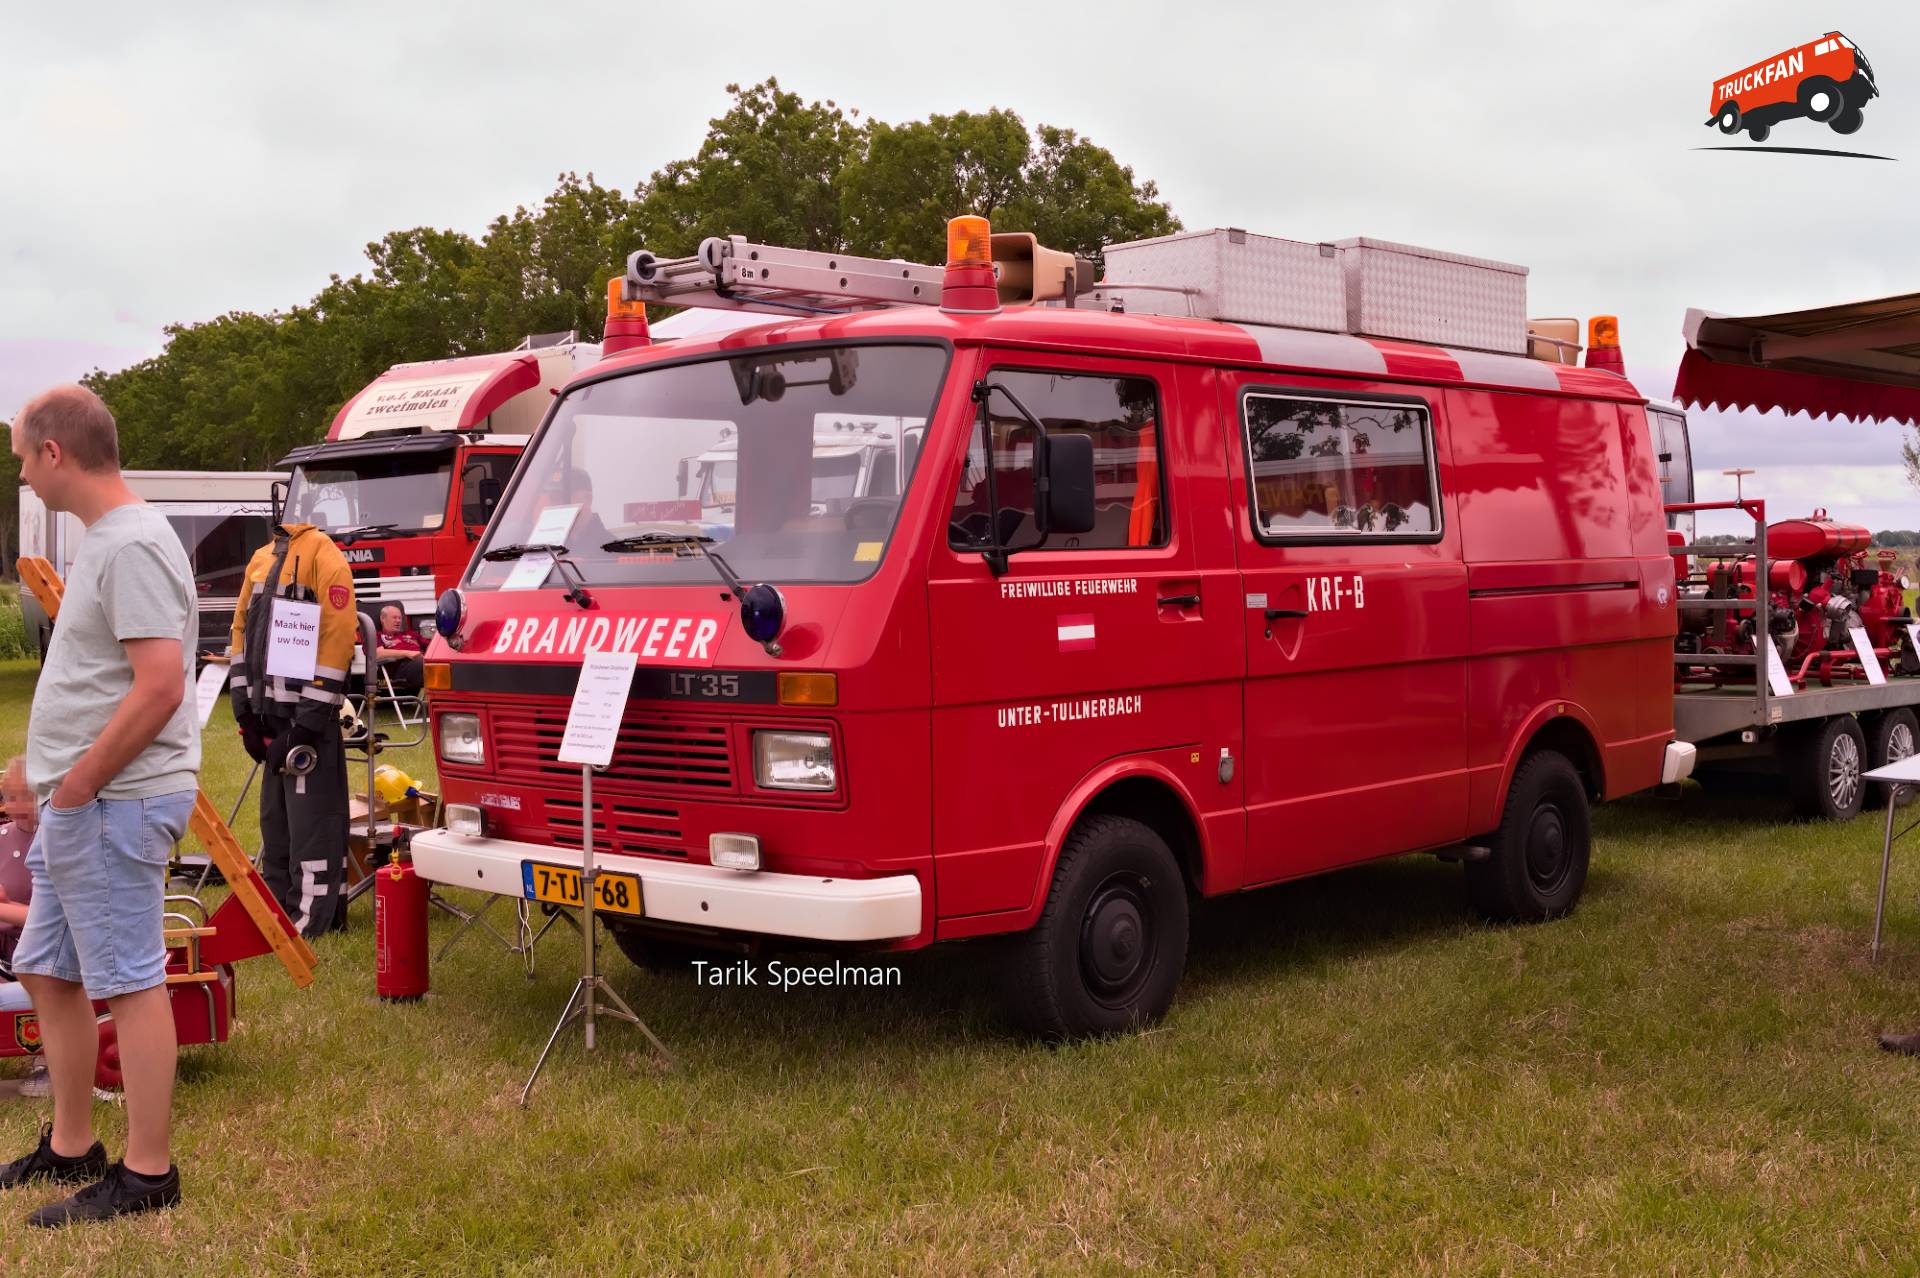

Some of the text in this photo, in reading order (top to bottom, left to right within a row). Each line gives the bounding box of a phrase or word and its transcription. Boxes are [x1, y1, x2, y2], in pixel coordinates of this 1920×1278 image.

[411, 386, 461, 399] BRAAK
[366, 398, 449, 416] zweefmolen
[342, 549, 375, 563] ANIA
[1001, 578, 1138, 599] FREIWILLIGE FEUERWEHR
[1306, 575, 1365, 612] KRF-B
[274, 619, 316, 632] Maak hier
[277, 635, 310, 647] uw foto
[493, 617, 719, 659] BRANDWEER
[670, 673, 739, 697] LT 35
[997, 696, 1142, 728] UNTER-TULLNERBACH
[538, 870, 630, 909] 7-TJ-68
